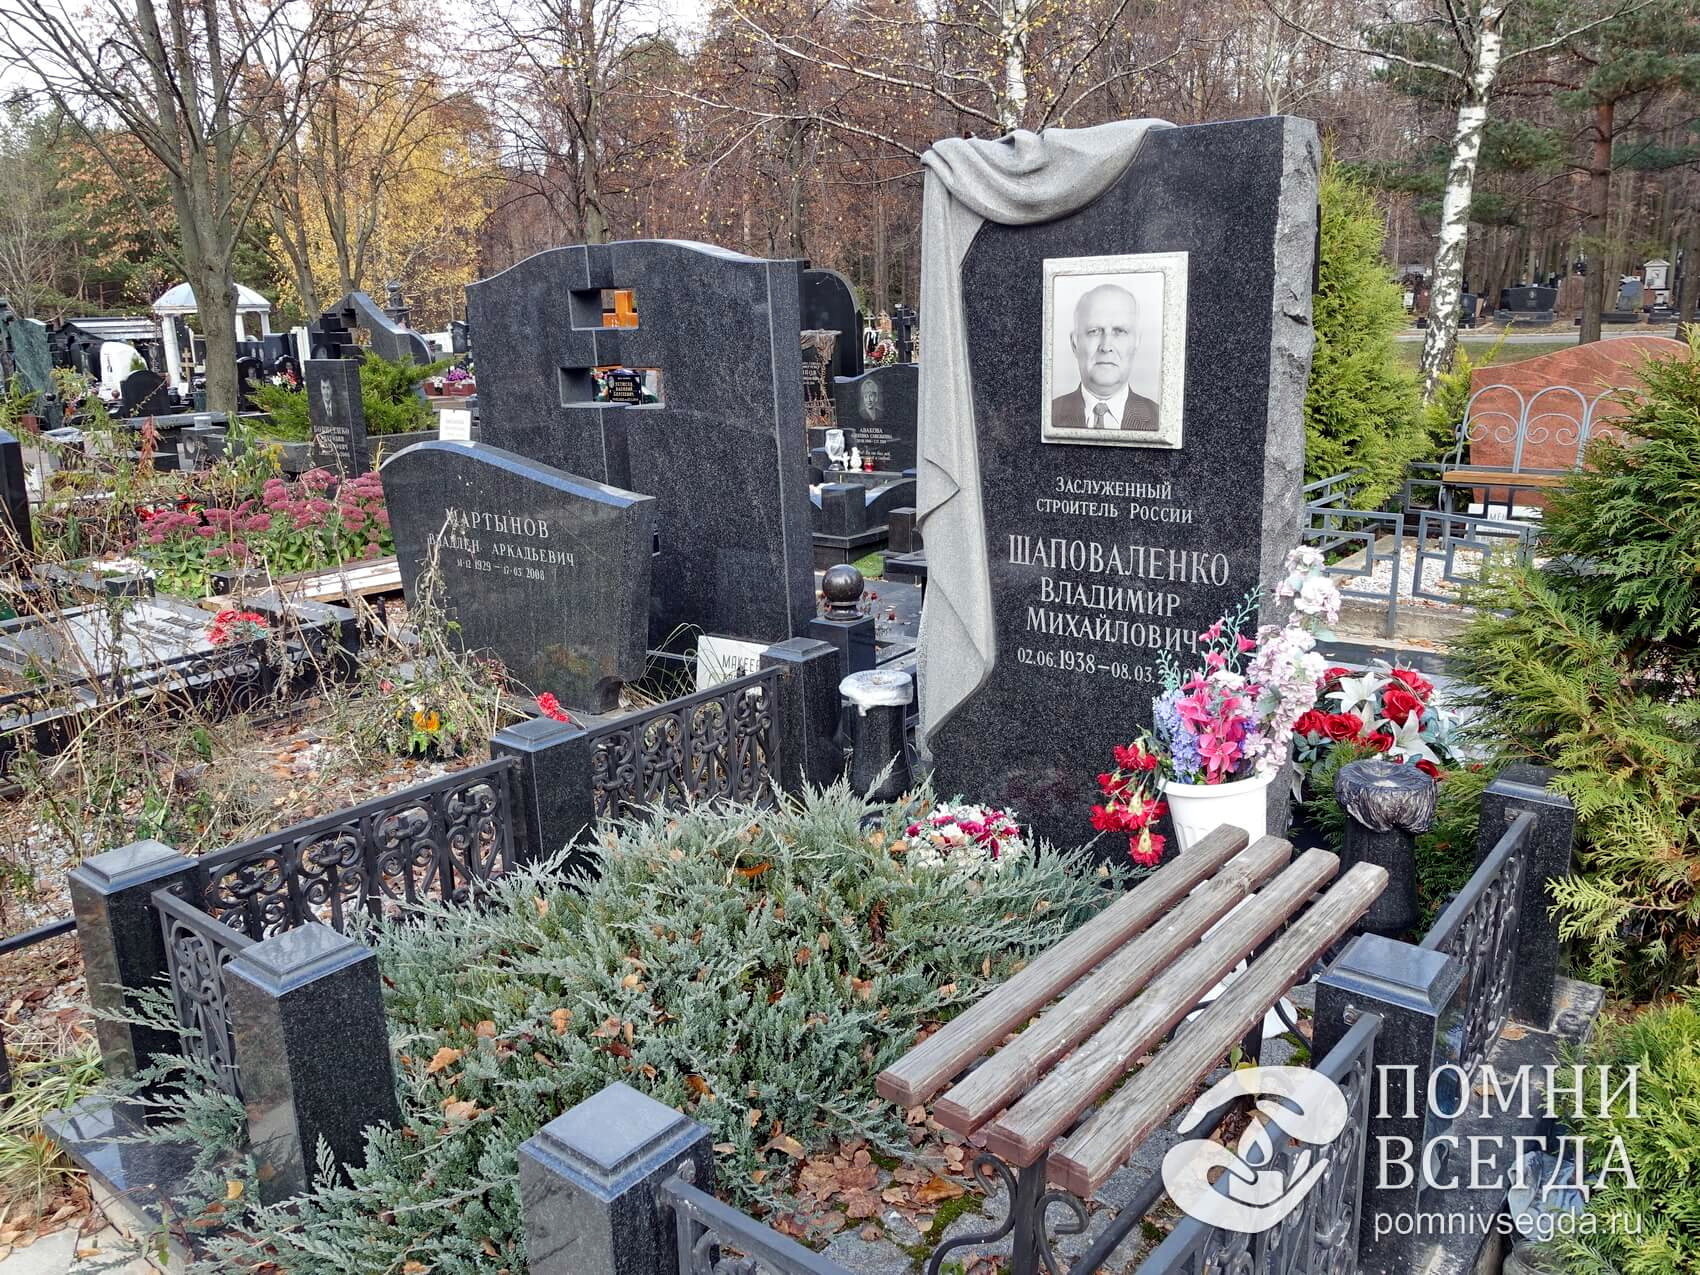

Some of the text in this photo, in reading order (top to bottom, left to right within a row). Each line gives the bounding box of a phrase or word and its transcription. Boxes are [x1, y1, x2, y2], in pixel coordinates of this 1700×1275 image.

[1055, 476, 1172, 500] ЗАСЛУЖЕННЫЙ
[445, 508, 550, 539] МАРТЫНОВ
[1036, 498, 1193, 524] СТРОИТЕЛЬ РОССИИ
[491, 542, 576, 567] АРКАДЬЕВИЧ
[1008, 534, 1230, 587] ШАПОВАЛЕНКО
[1040, 576, 1181, 617] ВЛАДИМИР
[1026, 606, 1200, 655] МИХАЙЛОВИЧ
